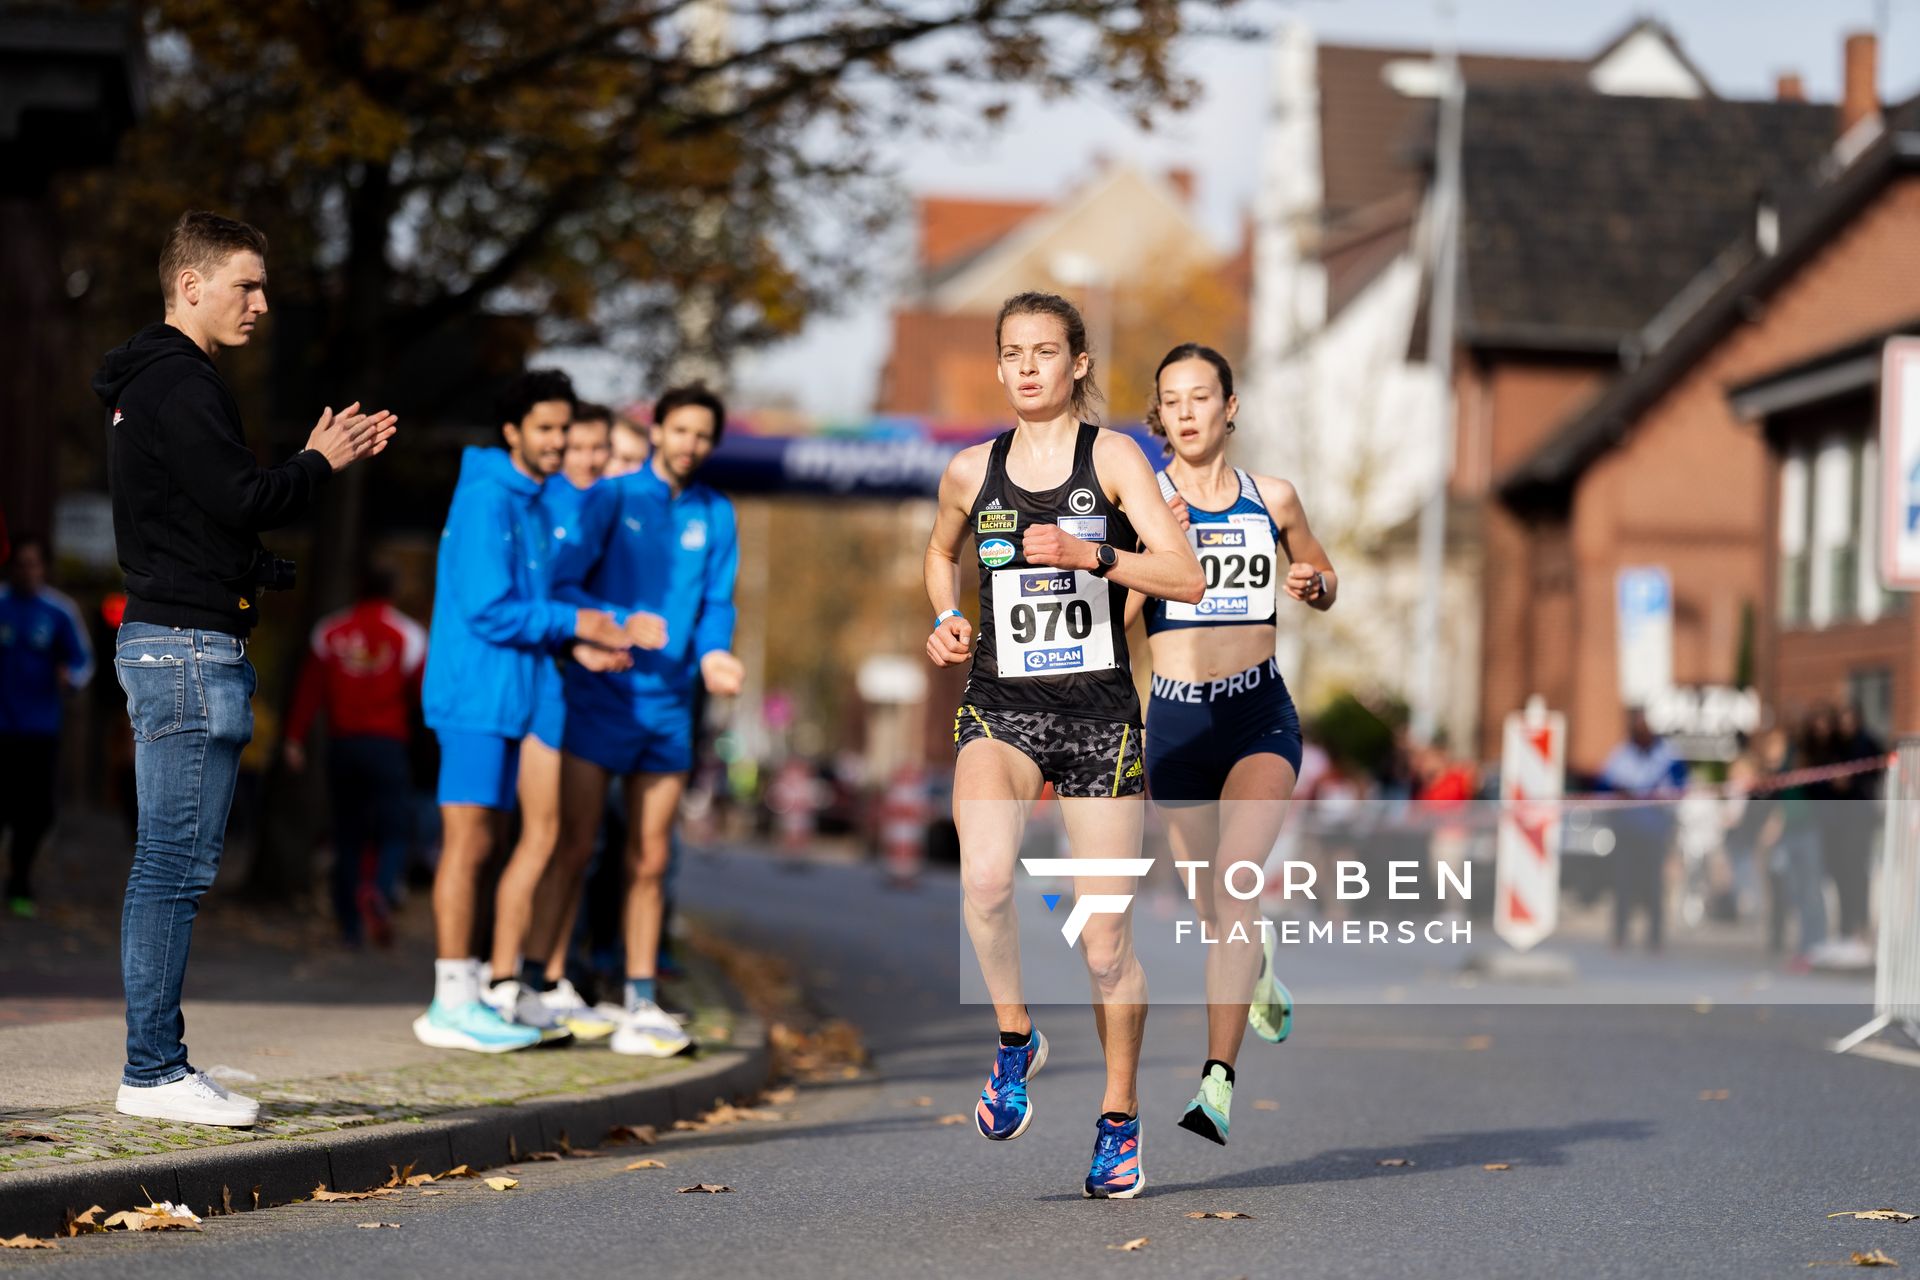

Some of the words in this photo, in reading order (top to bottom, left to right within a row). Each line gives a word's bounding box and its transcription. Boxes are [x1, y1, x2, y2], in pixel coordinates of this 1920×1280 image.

[1222, 533, 1243, 545] GLS
[1199, 554, 1271, 589] 029
[1049, 578, 1071, 591] GLS
[1216, 598, 1247, 609] PLAN
[1010, 599, 1093, 644] 970
[1048, 650, 1081, 662] PLAN
[1150, 674, 1205, 704] NIKE
[1209, 666, 1261, 702] PRO
